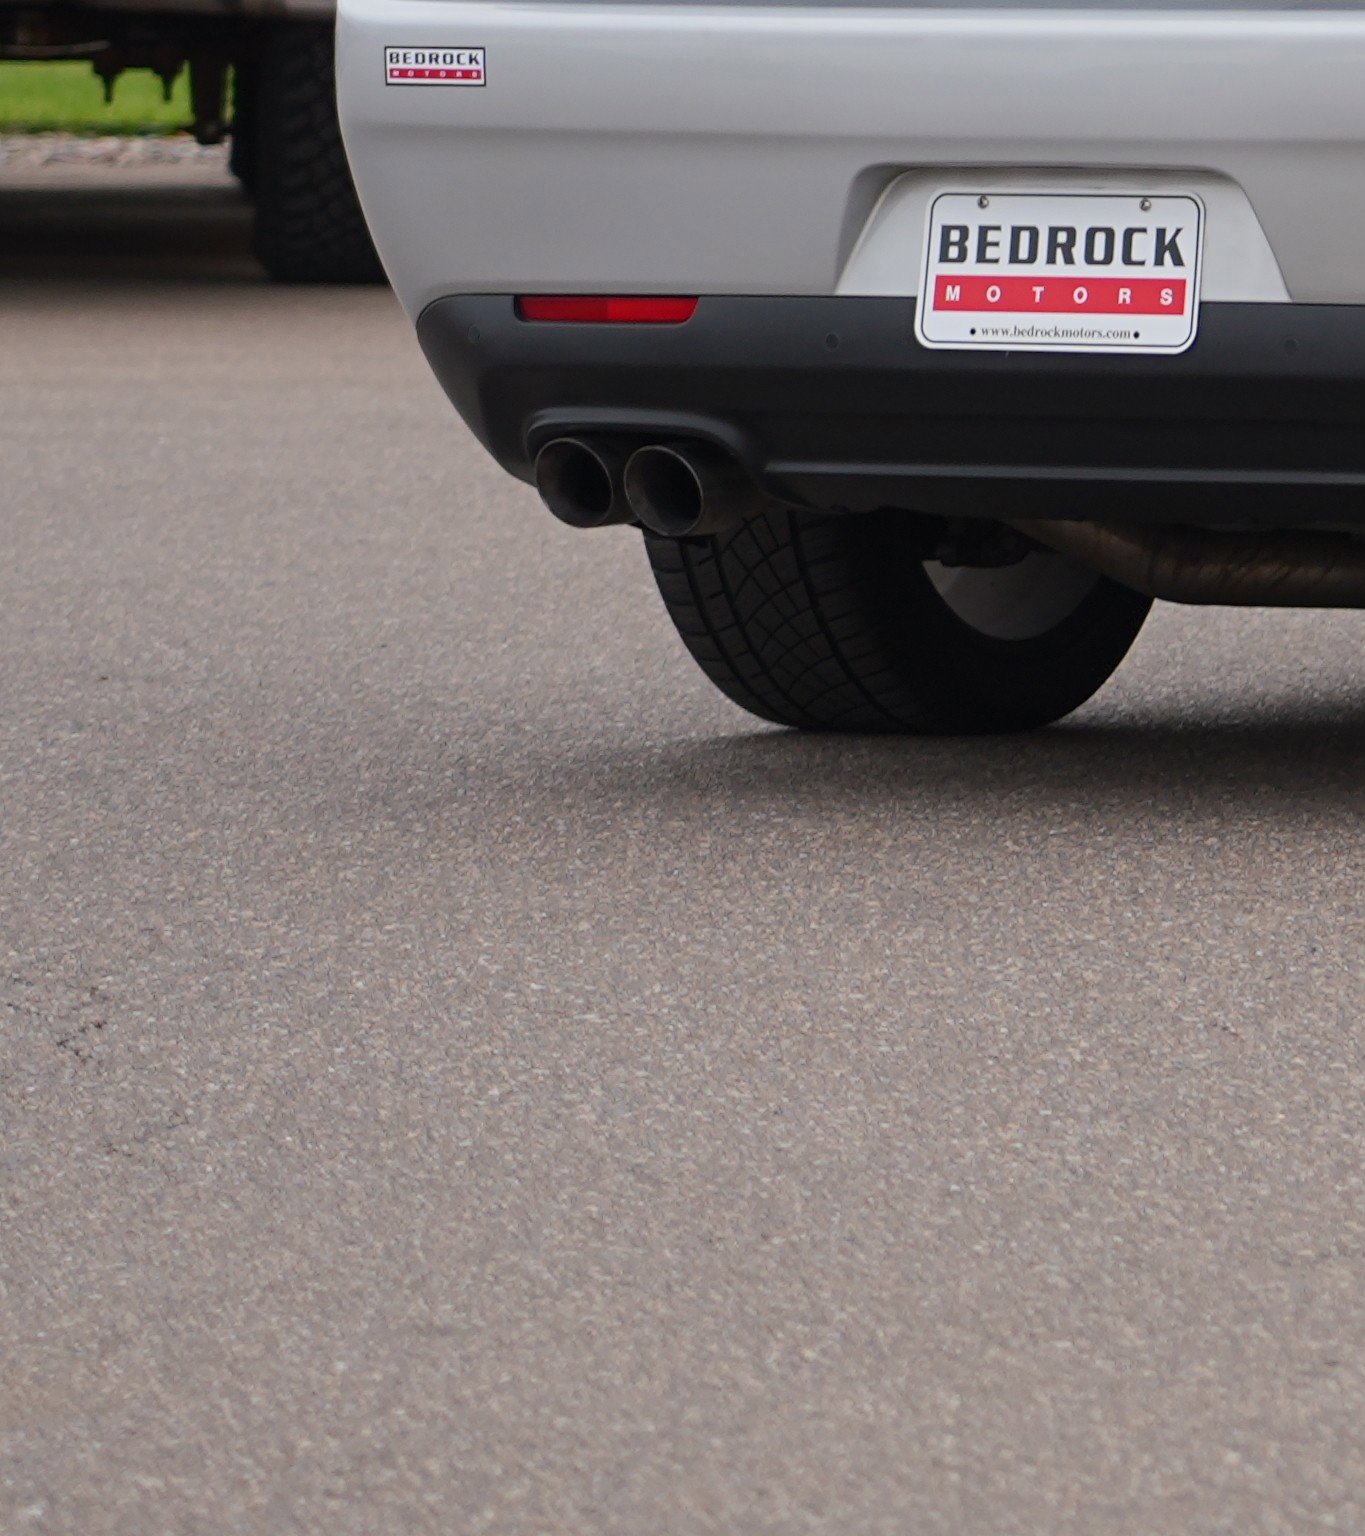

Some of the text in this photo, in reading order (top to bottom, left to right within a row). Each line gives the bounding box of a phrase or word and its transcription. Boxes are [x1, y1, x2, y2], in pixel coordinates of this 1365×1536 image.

[389, 52, 480, 65] BEDROCK
[938, 224, 1186, 267] BEDROCK
[945, 284, 1174, 306] MOTORS
[981, 325, 1131, 340] www.bedrockmotors.com
